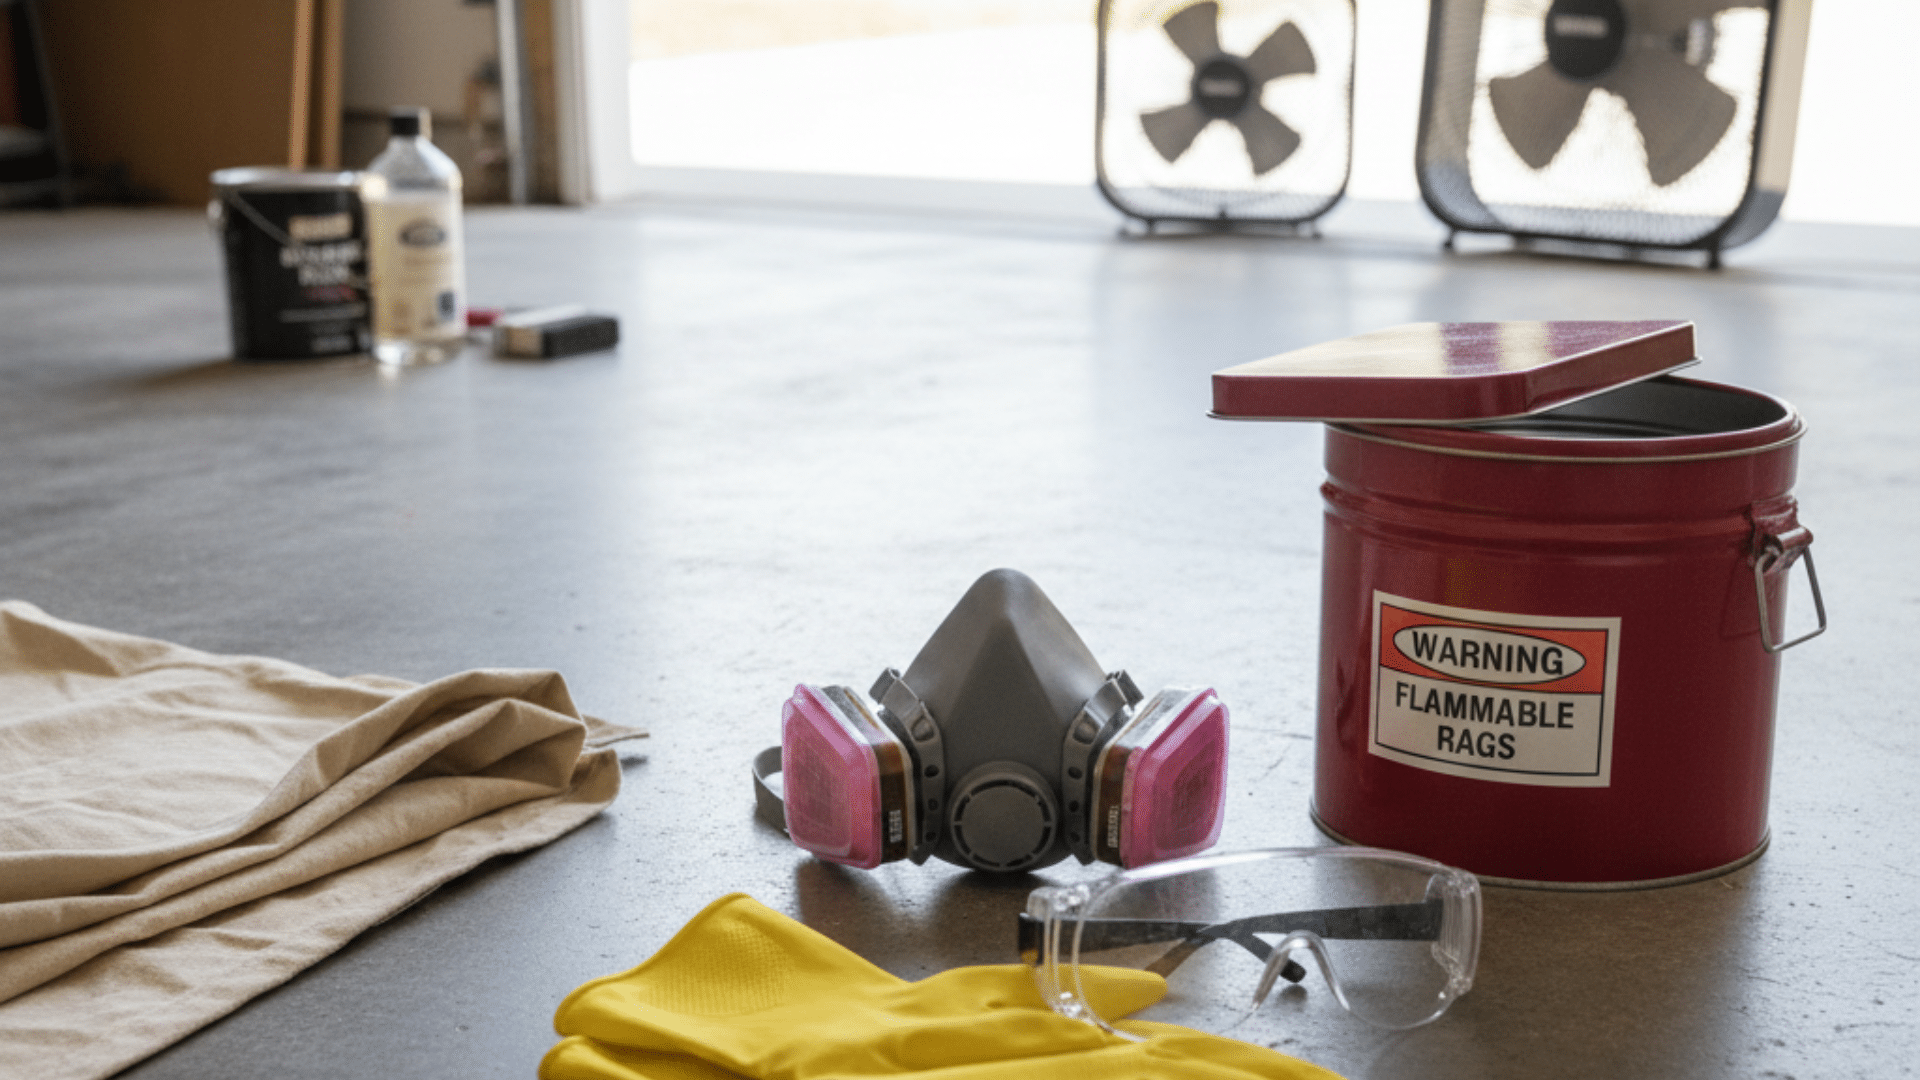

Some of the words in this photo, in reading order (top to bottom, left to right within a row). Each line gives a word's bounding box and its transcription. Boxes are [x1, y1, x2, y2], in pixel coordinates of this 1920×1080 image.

[1413, 631, 1564, 676] WARNING
[1396, 681, 1574, 729] FLAMMABLE
[1437, 725, 1516, 760] RAGS
